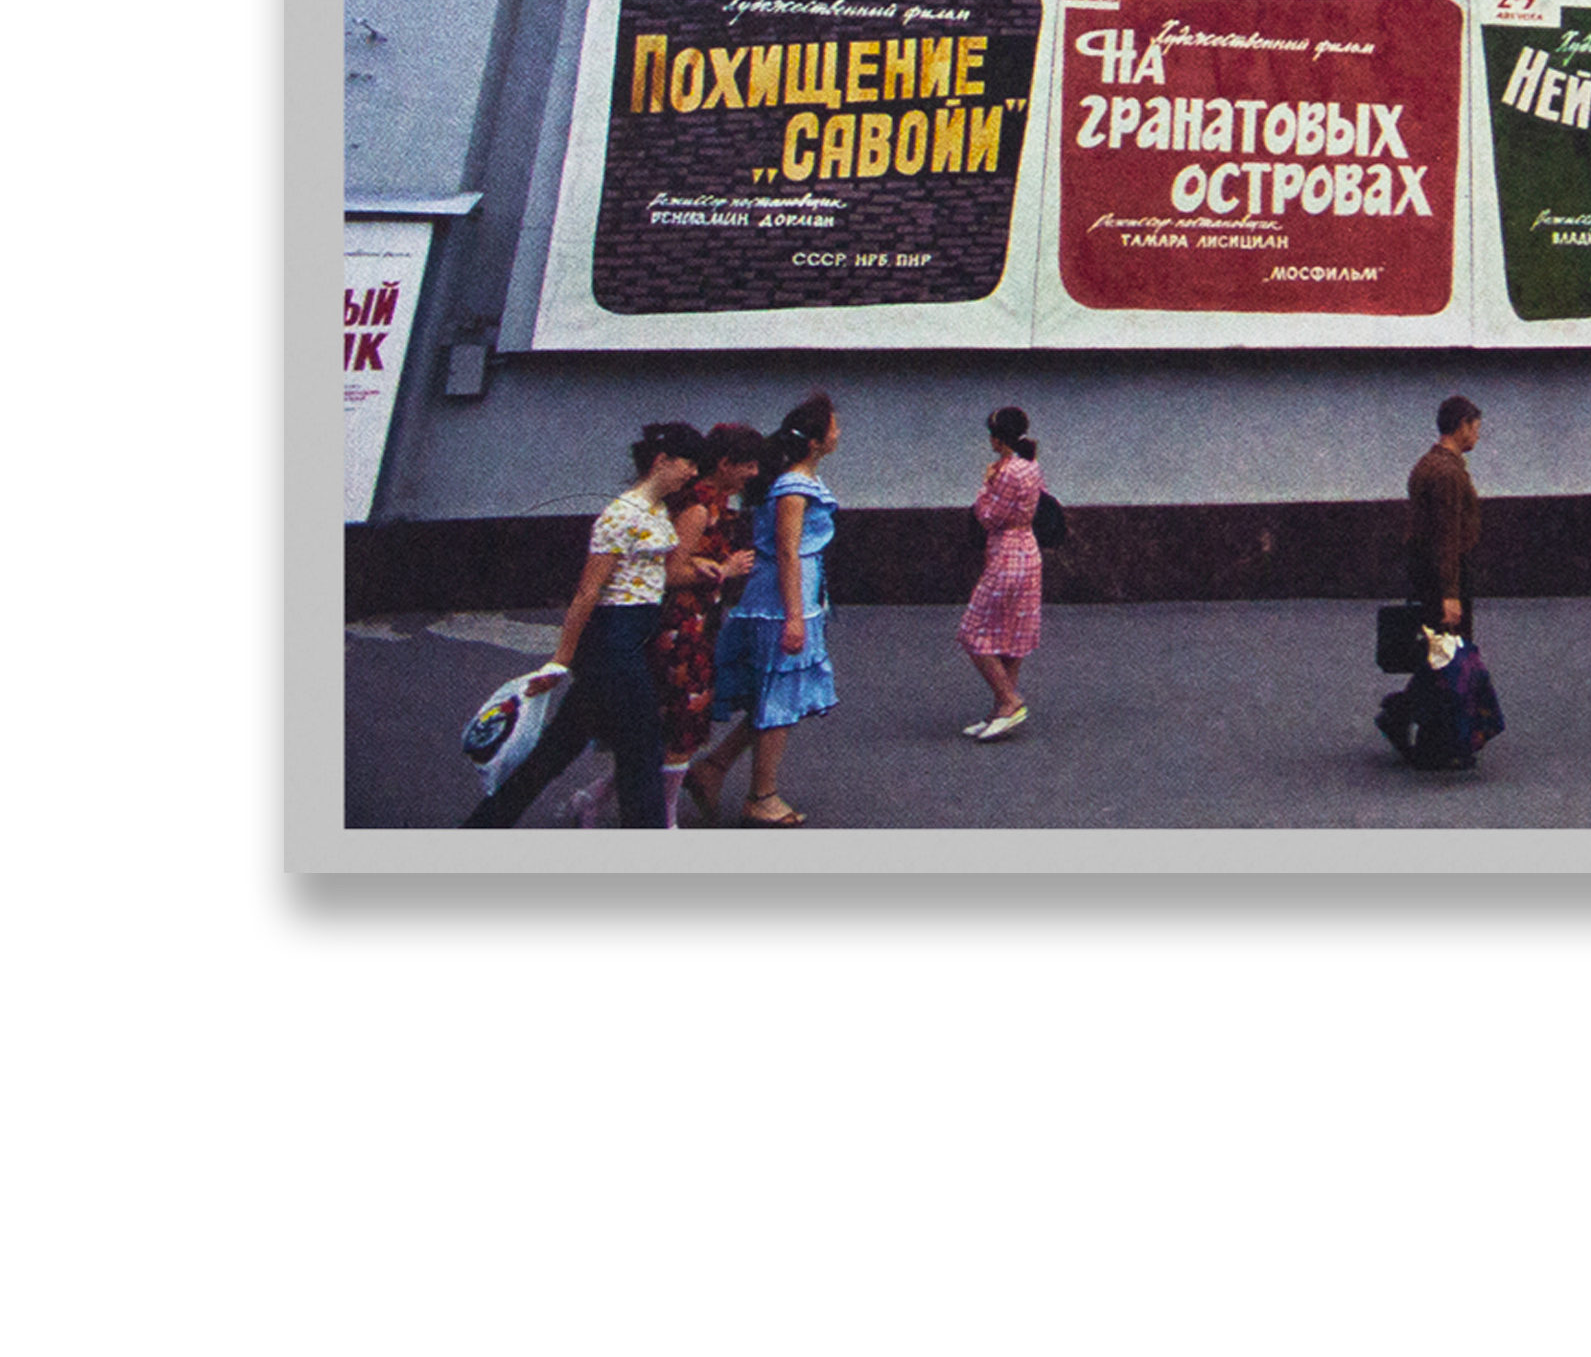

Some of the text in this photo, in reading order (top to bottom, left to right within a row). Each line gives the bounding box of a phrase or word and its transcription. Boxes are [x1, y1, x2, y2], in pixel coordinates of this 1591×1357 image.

[1075, 28, 1165, 84] НА
[1121, 233, 1289, 249] ТАМАРА ЛИСИЦИАН
[895, 253, 932, 267] ПНР
